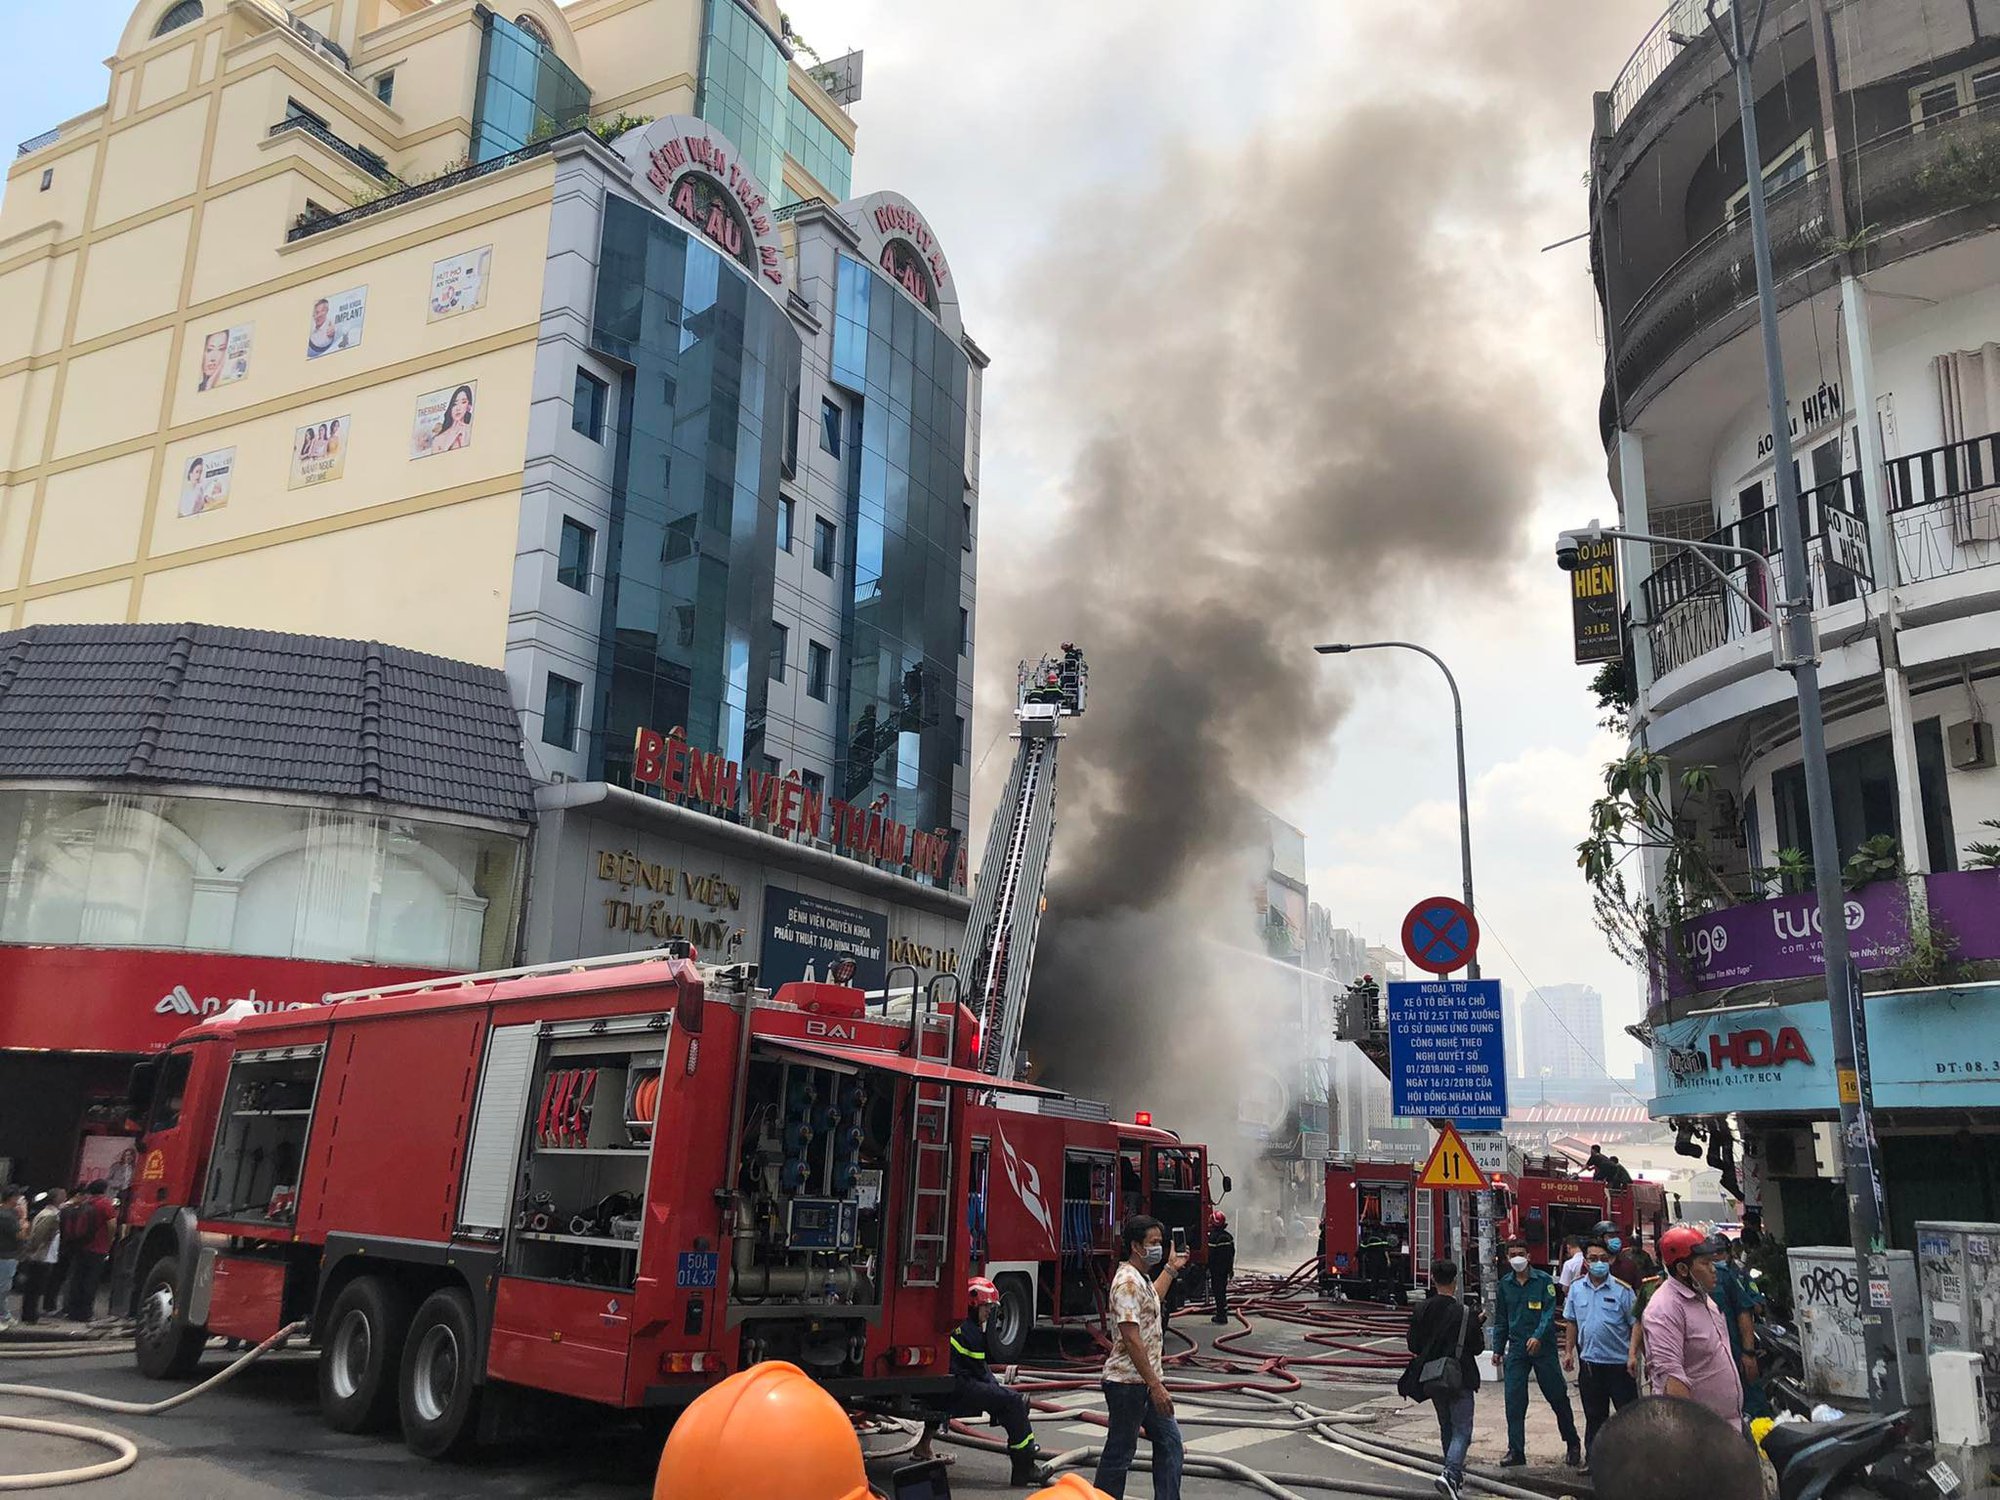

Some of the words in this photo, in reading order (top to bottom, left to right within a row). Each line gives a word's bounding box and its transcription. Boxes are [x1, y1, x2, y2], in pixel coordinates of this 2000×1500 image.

[335, 306, 363, 324] IMPLANT
[1802, 381, 1840, 424] HIỀN
[1574, 560, 1614, 598] HIỀN
[1584, 623, 1610, 636] 31B
[633, 725, 738, 810] BỆNH
[748, 768, 823, 841] VIỆN
[829, 791, 908, 866] THẨM
[911, 827, 949, 880] MỸ
[598, 849, 675, 896] BỆNH
[681, 873, 741, 913] VIỆN
[601, 900, 685, 939] THẨM
[688, 919, 730, 951] MỸ
[788, 906, 808, 925] BỆNH
[809, 912, 825, 930] VIỆN
[826, 919, 853, 935] CHUYÊN
[853, 924, 871, 939] KHOA
[774, 923, 794, 941] PHẪU
[795, 930, 818, 948] THUẬT
[819, 937, 833, 952] TẠO
[870, 946, 881, 960] MỸ
[1682, 925, 1727, 968] ugo
[888, 936, 933, 969] RĂNG
[1421, 984, 1447, 994] NGOẠI
[1451, 982, 1468, 993] TRỪ
[1404, 998, 1414, 1007] XE
[1416, 996, 1422, 1007] Ô
[1425, 996, 1435, 1007] TÔ
[1457, 998, 1466, 1006] 16
[1391, 1012, 1401, 1020] XE
[1404, 1009, 1416, 1020] TẢI
[1419, 1009, 1429, 1020] TỪ
[1431, 1011, 1449, 1020] 2.5T
[1471, 1007, 1500, 1019] XUỐNG
[806, 1020, 856, 1040] BAI
[1398, 1023, 1409, 1033] CÓ
[1411, 1022, 1423, 1033] SỬ
[1425, 1024, 1448, 1035] DỤNG
[1450, 1021, 1468, 1033] ỨNG
[1470, 1024, 1494, 1034] DỤNG
[1410, 1037, 1433, 1047] CÔNG
[1435, 1036, 1458, 1048] NGHỆ
[1461, 1037, 1483, 1047] THEO
[1709, 1027, 1815, 1070] HOA
[1416, 1051, 1436, 1062] NGHỊ
[1437, 1048, 1465, 1060] QUYẾT
[1467, 1048, 1479, 1060] SỐ
[1406, 1064, 1456, 1074] 01/2018/NQ
[1406, 1076, 1428, 1087] NGÀY
[1431, 1078, 1474, 1087] 16/3/2018
[1475, 1075, 1493, 1087] CỦA
[1845, 1081, 1857, 1092] 16
[1407, 1090, 1422, 1102] HỘI
[1424, 1089, 1447, 1101] ĐỒNG
[1449, 1090, 1472, 1101] NHÂN
[1474, 1090, 1492, 1101] DÂN
[1400, 1104, 1427, 1115] THÀNH
[1429, 1102, 1448, 1115] PHỐ
[1448, 1102, 1460, 1115] HỒ
[1462, 1103, 1477, 1115] CHÍ
[1478, 1105, 1501, 1115] MINH
[687, 1253, 709, 1269] 50A
